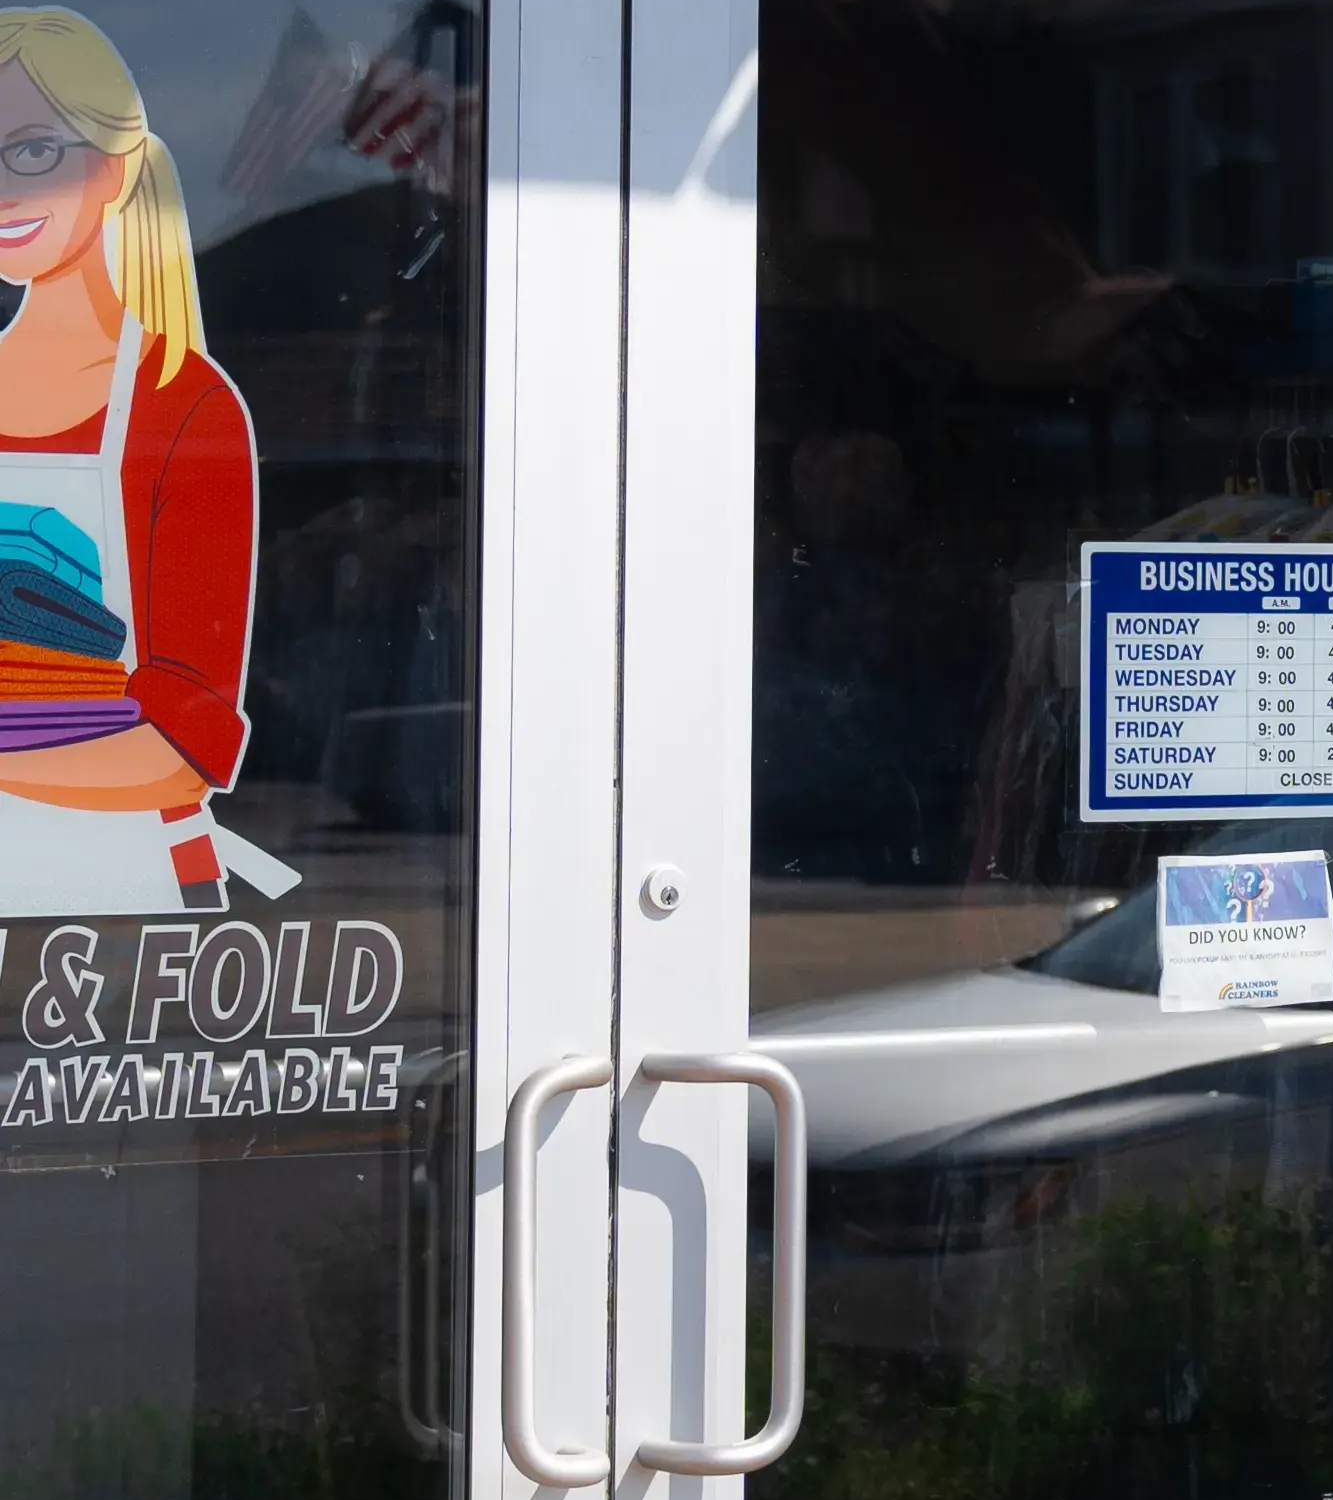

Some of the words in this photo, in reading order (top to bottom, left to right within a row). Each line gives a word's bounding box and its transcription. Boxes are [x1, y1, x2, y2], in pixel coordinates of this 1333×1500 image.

[1140, 561, 1275, 591] BUSINESS
[1115, 618, 1200, 635] MONDAY
[1115, 644, 1204, 660] TUESDAY
[1115, 670, 1236, 686] WEDNESDAY
[1115, 696, 1219, 712] THURSDAY
[1115, 722, 1184, 738] FRIDAY
[1114, 747, 1216, 764] SATURDAY
[1114, 773, 1194, 790] SUNDAY
[1189, 931, 1214, 945] DID
[1218, 929, 1248, 943] YOU
[1253, 924, 1307, 941] KNOW?
[22, 925, 106, 1049] &
[126, 920, 404, 1044] FOLD
[1235, 980, 1278, 989] RAINBOW
[1228, 990, 1278, 1000] CLEANERS
[1, 1044, 405, 1127] AVAILABLE
